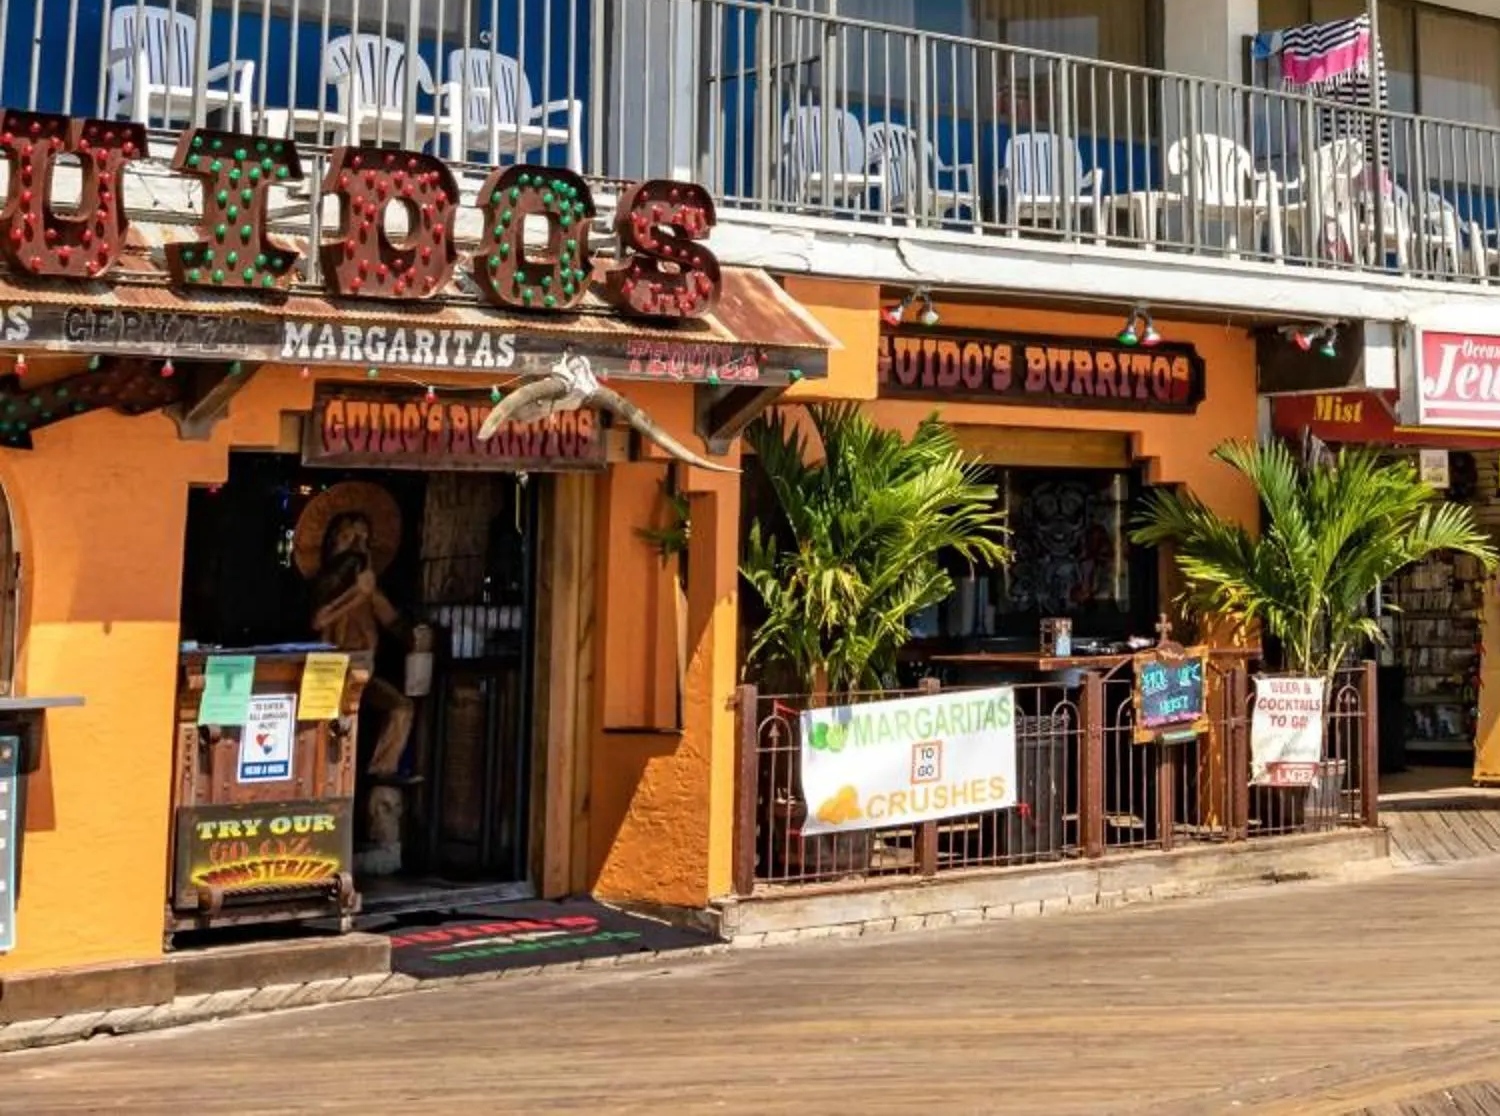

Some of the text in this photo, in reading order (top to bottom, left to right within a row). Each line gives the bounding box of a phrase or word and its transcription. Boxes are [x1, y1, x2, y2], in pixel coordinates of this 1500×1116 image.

[281, 321, 516, 368] MARGARITAS
[626, 339, 760, 381] TEQUILA
[1023, 345, 1190, 403] BURRITOS
[1313, 395, 1363, 423] Mist
[323, 399, 445, 454] GUIDO'S
[1257, 697, 1321, 712] COCKTAILS
[853, 695, 1011, 747] MARGARITAS
[1270, 715, 1287, 727] TO
[920, 747, 934, 760] TO
[917, 765, 934, 777] GO
[866, 775, 1007, 820] CRUSHES
[195, 814, 336, 840] TRY OUR
